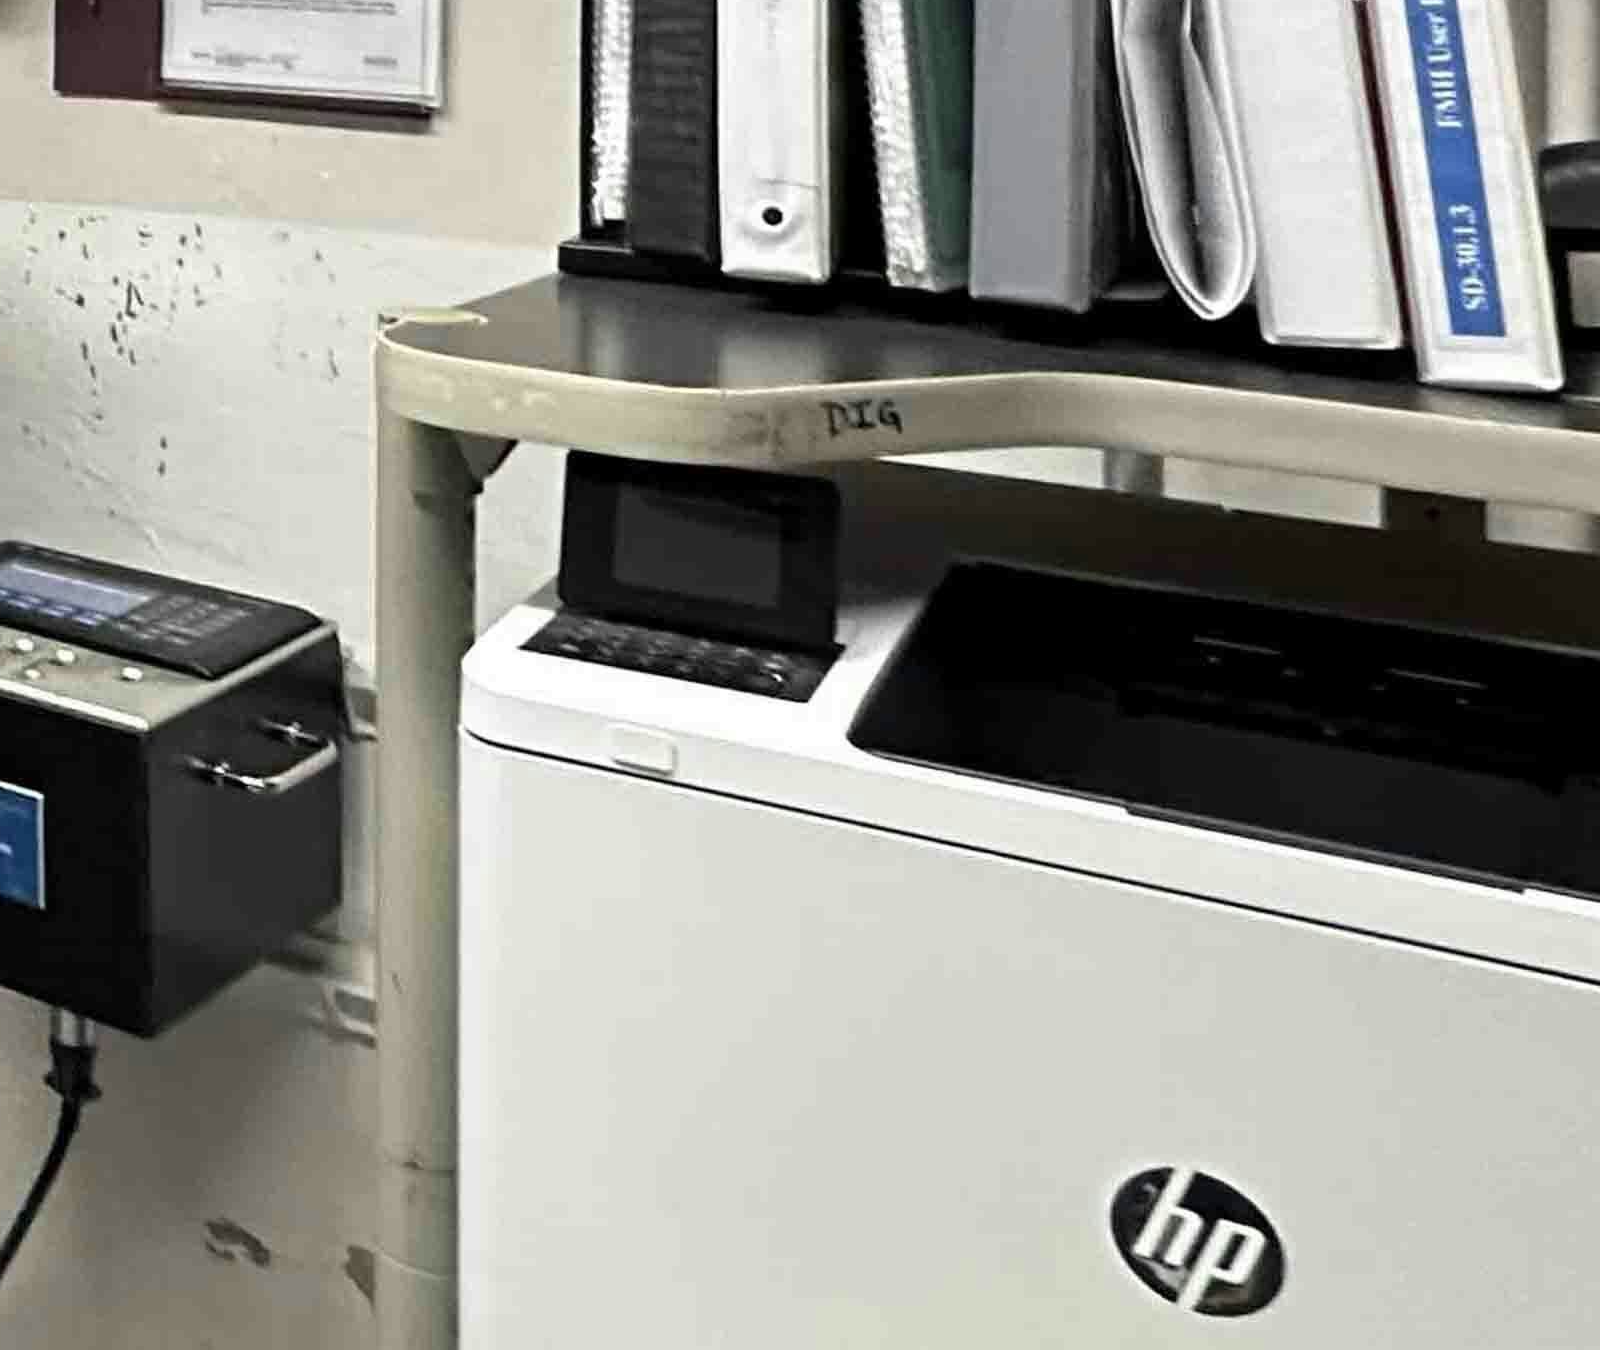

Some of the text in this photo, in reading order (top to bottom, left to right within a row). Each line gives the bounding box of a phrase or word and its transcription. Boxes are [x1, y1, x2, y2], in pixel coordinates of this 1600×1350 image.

[1426, 13, 1455, 65] User
[1450, 203, 1490, 311] SD-30.1.3
[819, 398, 904, 437] DIG
[1132, 1164, 1267, 1311] hp
